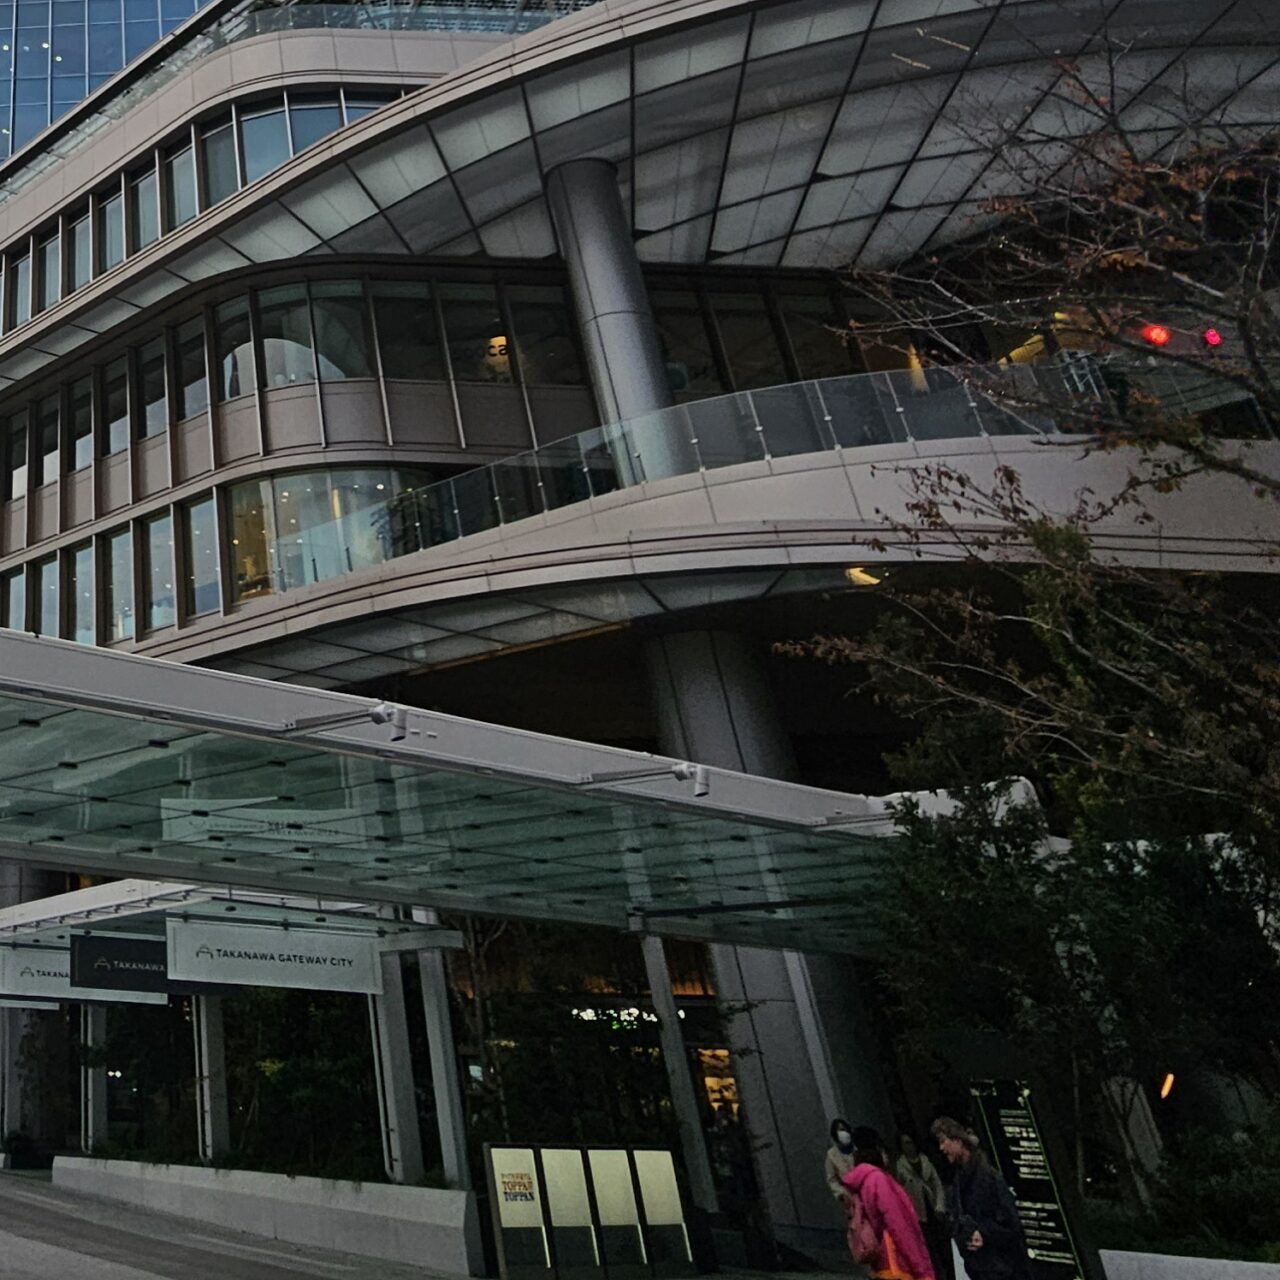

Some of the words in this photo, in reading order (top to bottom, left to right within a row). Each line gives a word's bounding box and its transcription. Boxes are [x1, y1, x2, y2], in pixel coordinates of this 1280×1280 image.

[113, 960, 165, 972] TAKANAWA
[216, 948, 275, 962] TAKANAWA
[278, 953, 327, 965] GATEWAY
[330, 957, 353, 968] CITY
